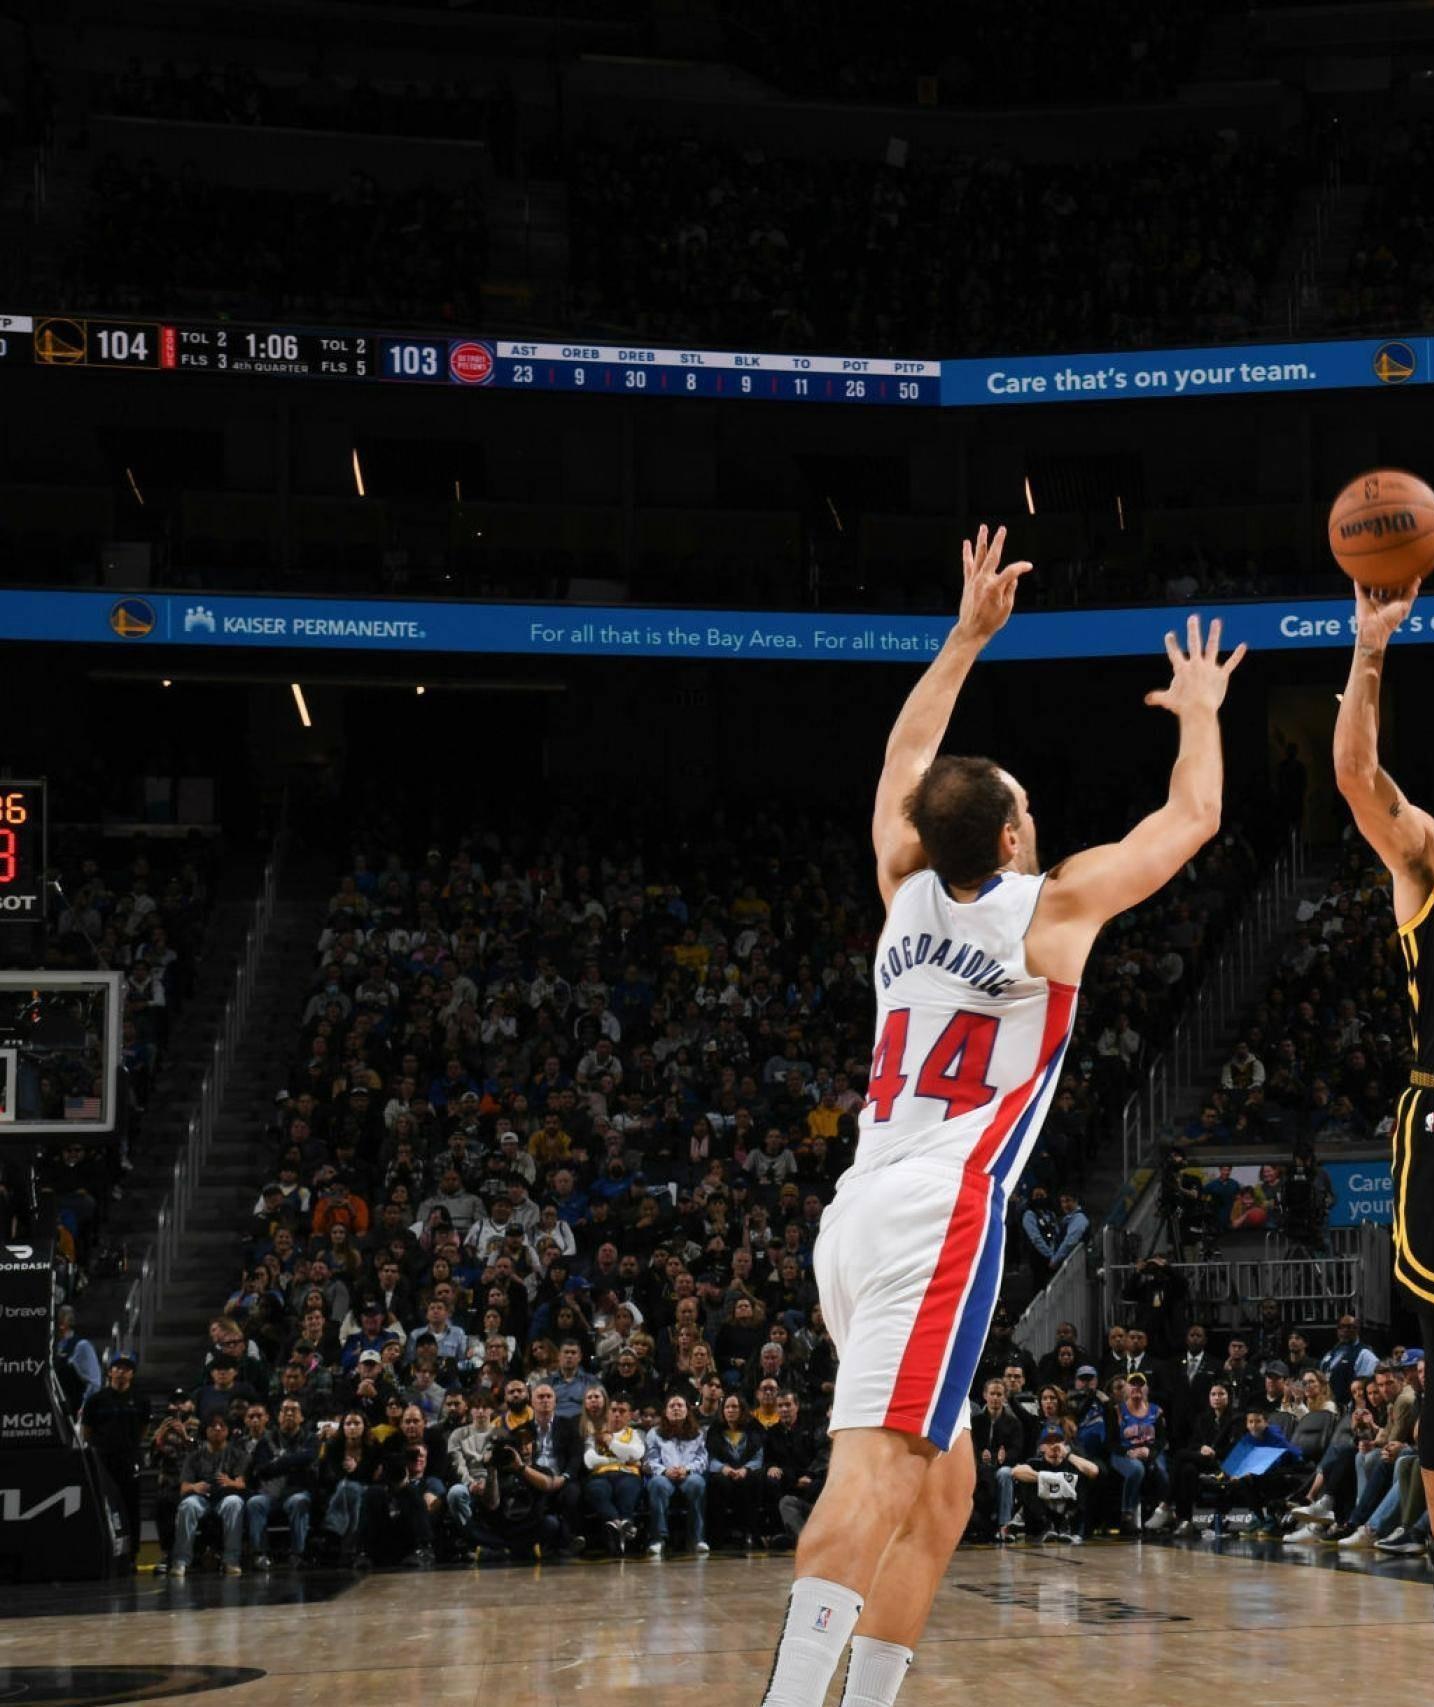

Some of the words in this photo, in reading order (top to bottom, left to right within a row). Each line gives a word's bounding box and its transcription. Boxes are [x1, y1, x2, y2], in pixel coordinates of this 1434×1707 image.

[97, 330, 148, 360] 104
[181, 332, 209, 344] TOL
[217, 331, 228, 347] 2
[246, 333, 298, 359] 1:06
[320, 339, 348, 351] TOL
[356, 339, 365, 354] 2
[181, 354, 208, 366] FLS
[217, 353, 228, 369] 3
[232, 361, 251, 371] 4th
[254, 362, 308, 374] QUARTER
[321, 361, 348, 373] FLS
[356, 361, 366, 376] 5
[390, 346, 437, 375] 103
[511, 346, 537, 357] AST
[562, 347, 600, 359] OREB
[618, 351, 655, 362] DREB
[680, 353, 704, 365] STL
[734, 356, 760, 367] BLK
[793, 359, 810, 369] TO
[842, 361, 868, 372] POT
[894, 362, 925, 374] PITP
[513, 365, 533, 383] 23
[574, 368, 585, 385] 9
[626, 371, 646, 389] 30
[686, 373, 697, 391] 8
[742, 376, 751, 393] 9
[795, 379, 808, 395] 11
[845, 380, 865, 398] 26
[900, 383, 918, 399] 50
[987, 371, 1047, 394] Care
[1135, 371, 1168, 388] on
[1174, 367, 1235, 395] your
[1240, 362, 1316, 383] team.
[223, 617, 286, 635] KAISER
[1280, 615, 1341, 637] Care
[531, 624, 564, 643] For
[570, 625, 593, 644] all
[600, 626, 640, 645] that
[646, 628, 662, 646] is
[667, 628, 700, 647] the
[708, 629, 744, 652] Bay
[749, 631, 802, 648] Area.
[814, 631, 847, 649] For
[852, 632, 874, 650] all
[880, 633, 919, 651] that
[924, 634, 939, 651] is
[0, 793, 26, 824] 6
[0, 895, 37, 910] OT
[867, 1007, 1001, 1123] 44
[1348, 1174, 1393, 1192] Care
[1348, 1199, 1394, 1220] your
[5, 1306, 47, 1317] brave
[3, 1412, 52, 1428] MGM
